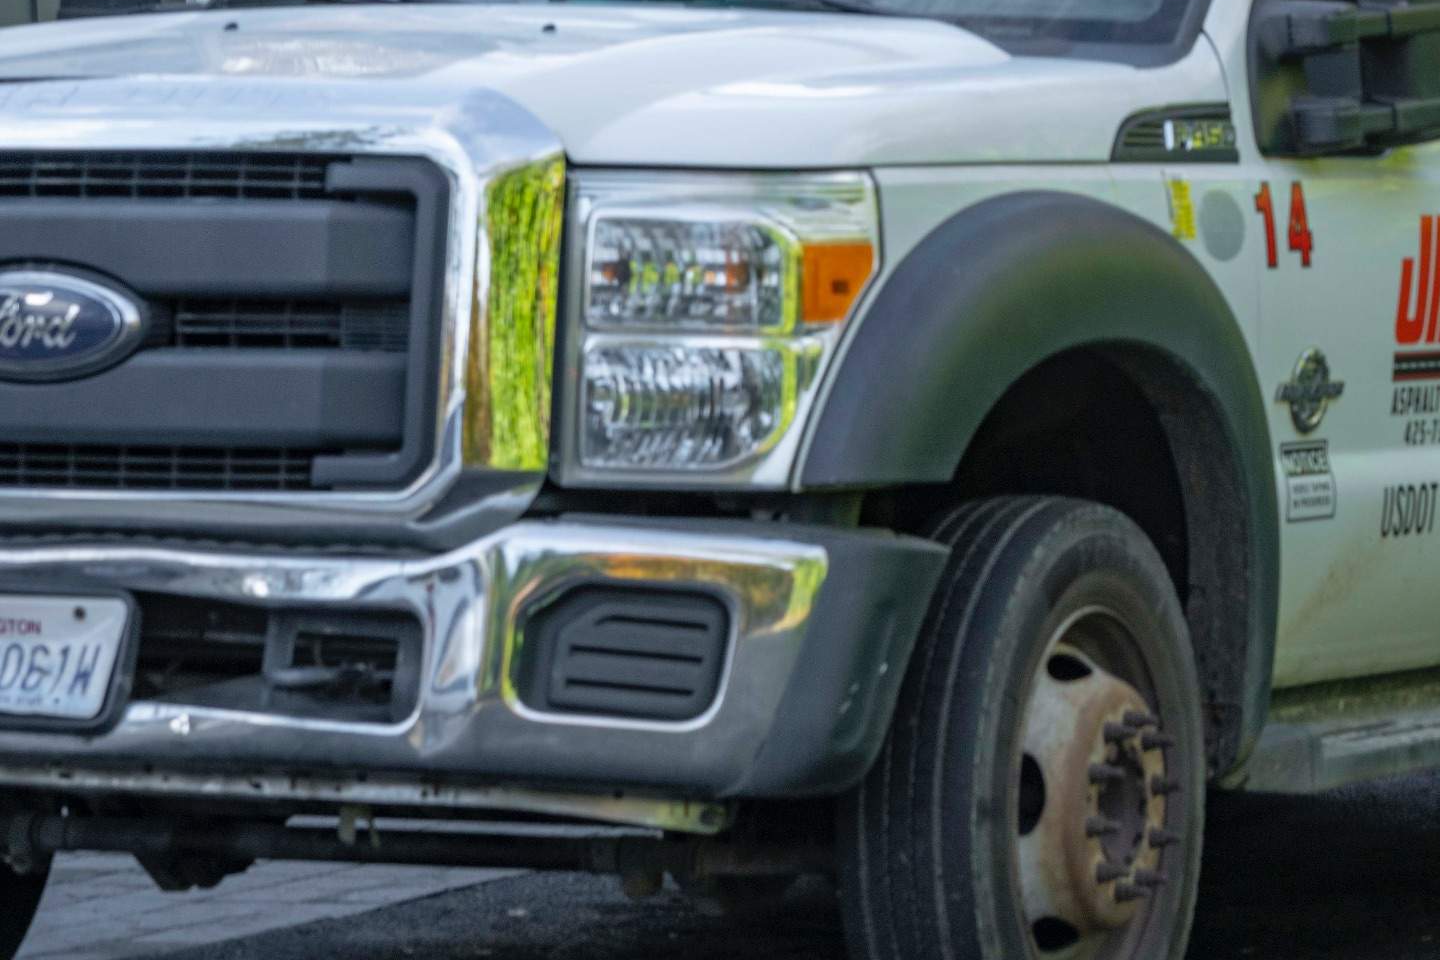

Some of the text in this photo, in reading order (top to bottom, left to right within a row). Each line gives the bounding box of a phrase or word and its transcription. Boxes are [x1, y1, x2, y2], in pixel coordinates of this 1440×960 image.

[1253, 180, 1314, 269] 14
[1391, 383, 1440, 416] ASPHALT
[1380, 481, 1439, 538] USDOT
